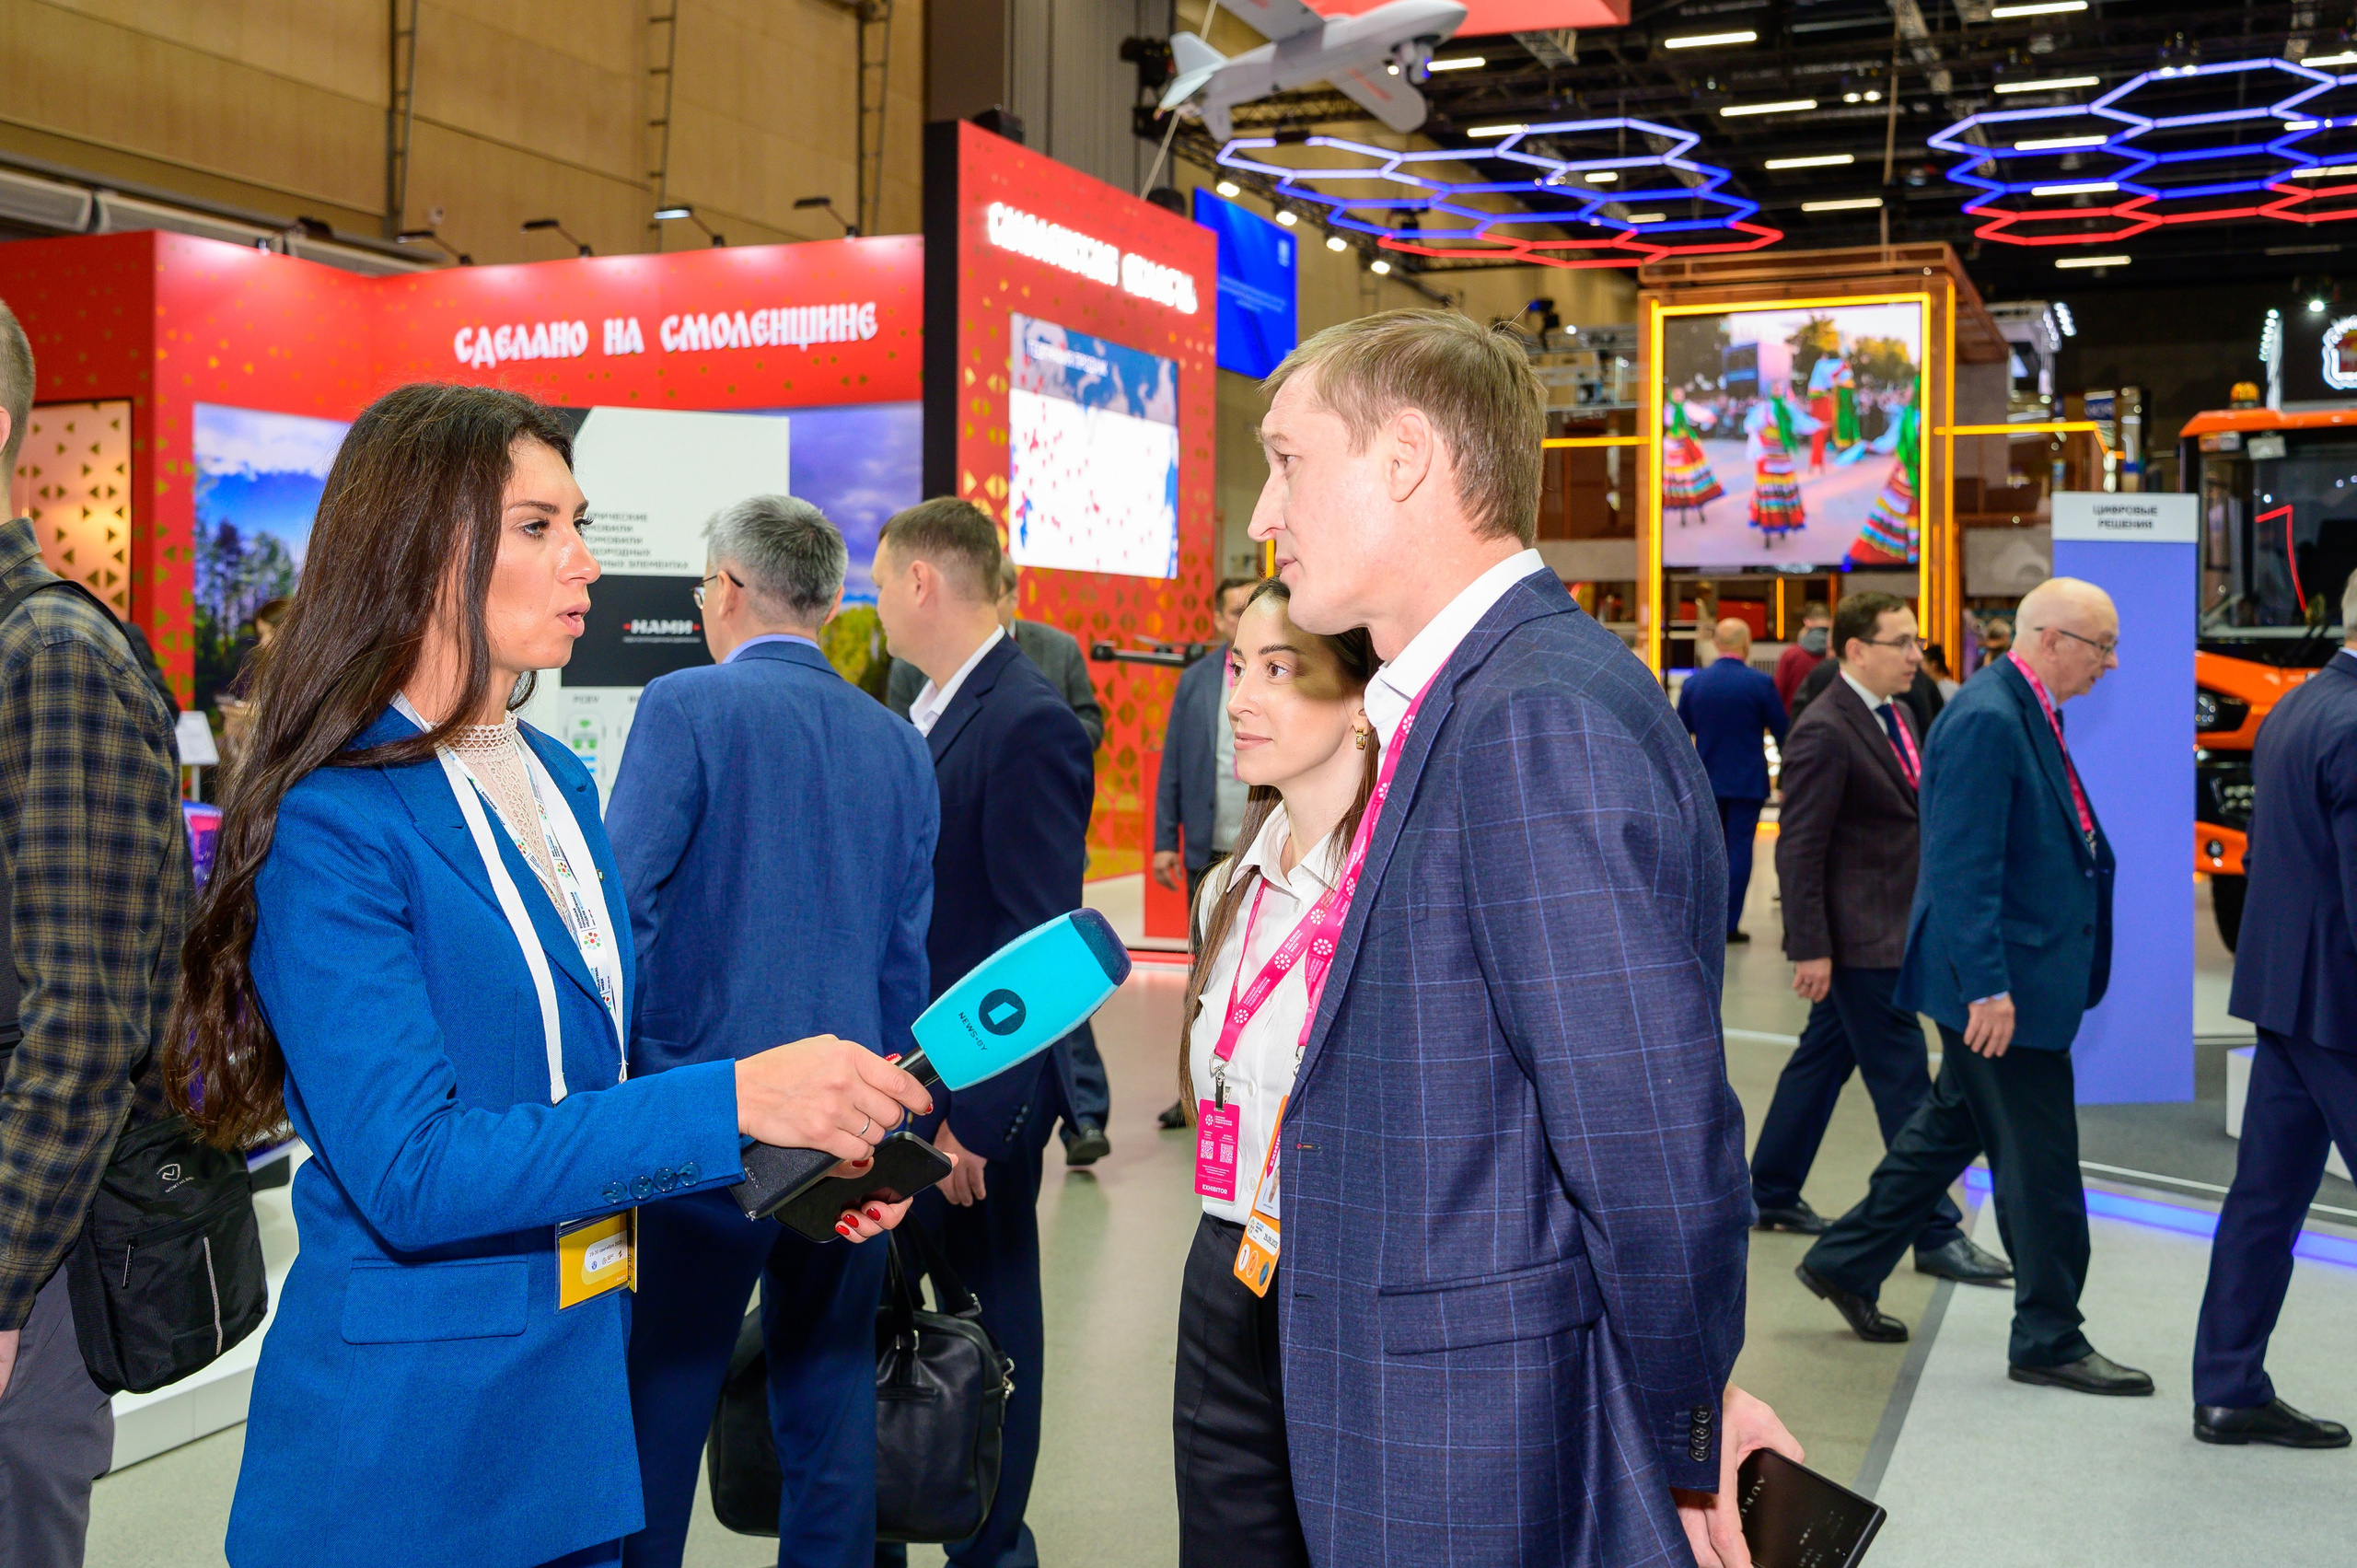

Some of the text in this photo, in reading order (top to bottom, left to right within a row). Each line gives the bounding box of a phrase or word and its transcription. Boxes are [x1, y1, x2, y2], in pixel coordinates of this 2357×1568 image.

[455, 302, 878, 369] СДЕЛАНО НА СМОЛЕНЩИНЕ
[2093, 505, 2157, 516] ЦИФРОВЫЕ
[2098, 520, 2153, 528] РЕШЕНИЯ
[631, 620, 693, 634] НАМИ
[1202, 1184, 1228, 1195] EXHIBITOR
